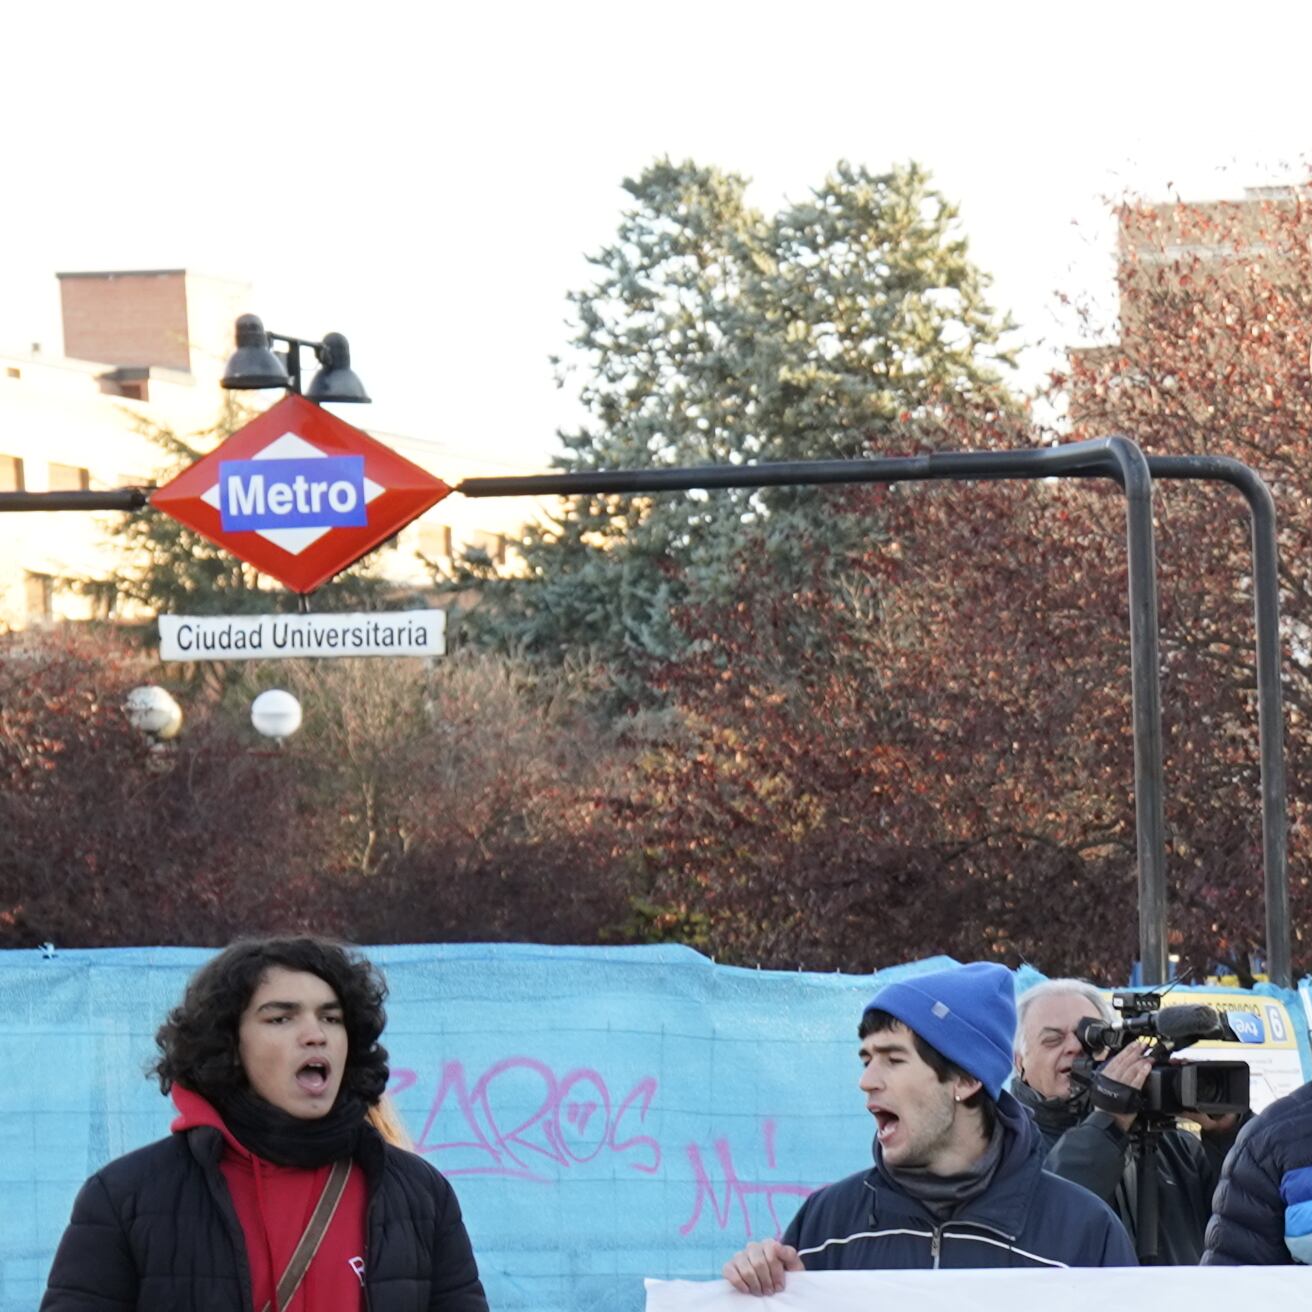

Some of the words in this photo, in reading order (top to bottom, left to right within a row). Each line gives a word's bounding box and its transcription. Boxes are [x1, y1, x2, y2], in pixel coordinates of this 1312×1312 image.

[226, 471, 358, 518] Metro
[176, 622, 265, 651] Ciudad
[272, 619, 429, 650] Universitaria
[1234, 1019, 1258, 1037] tve
